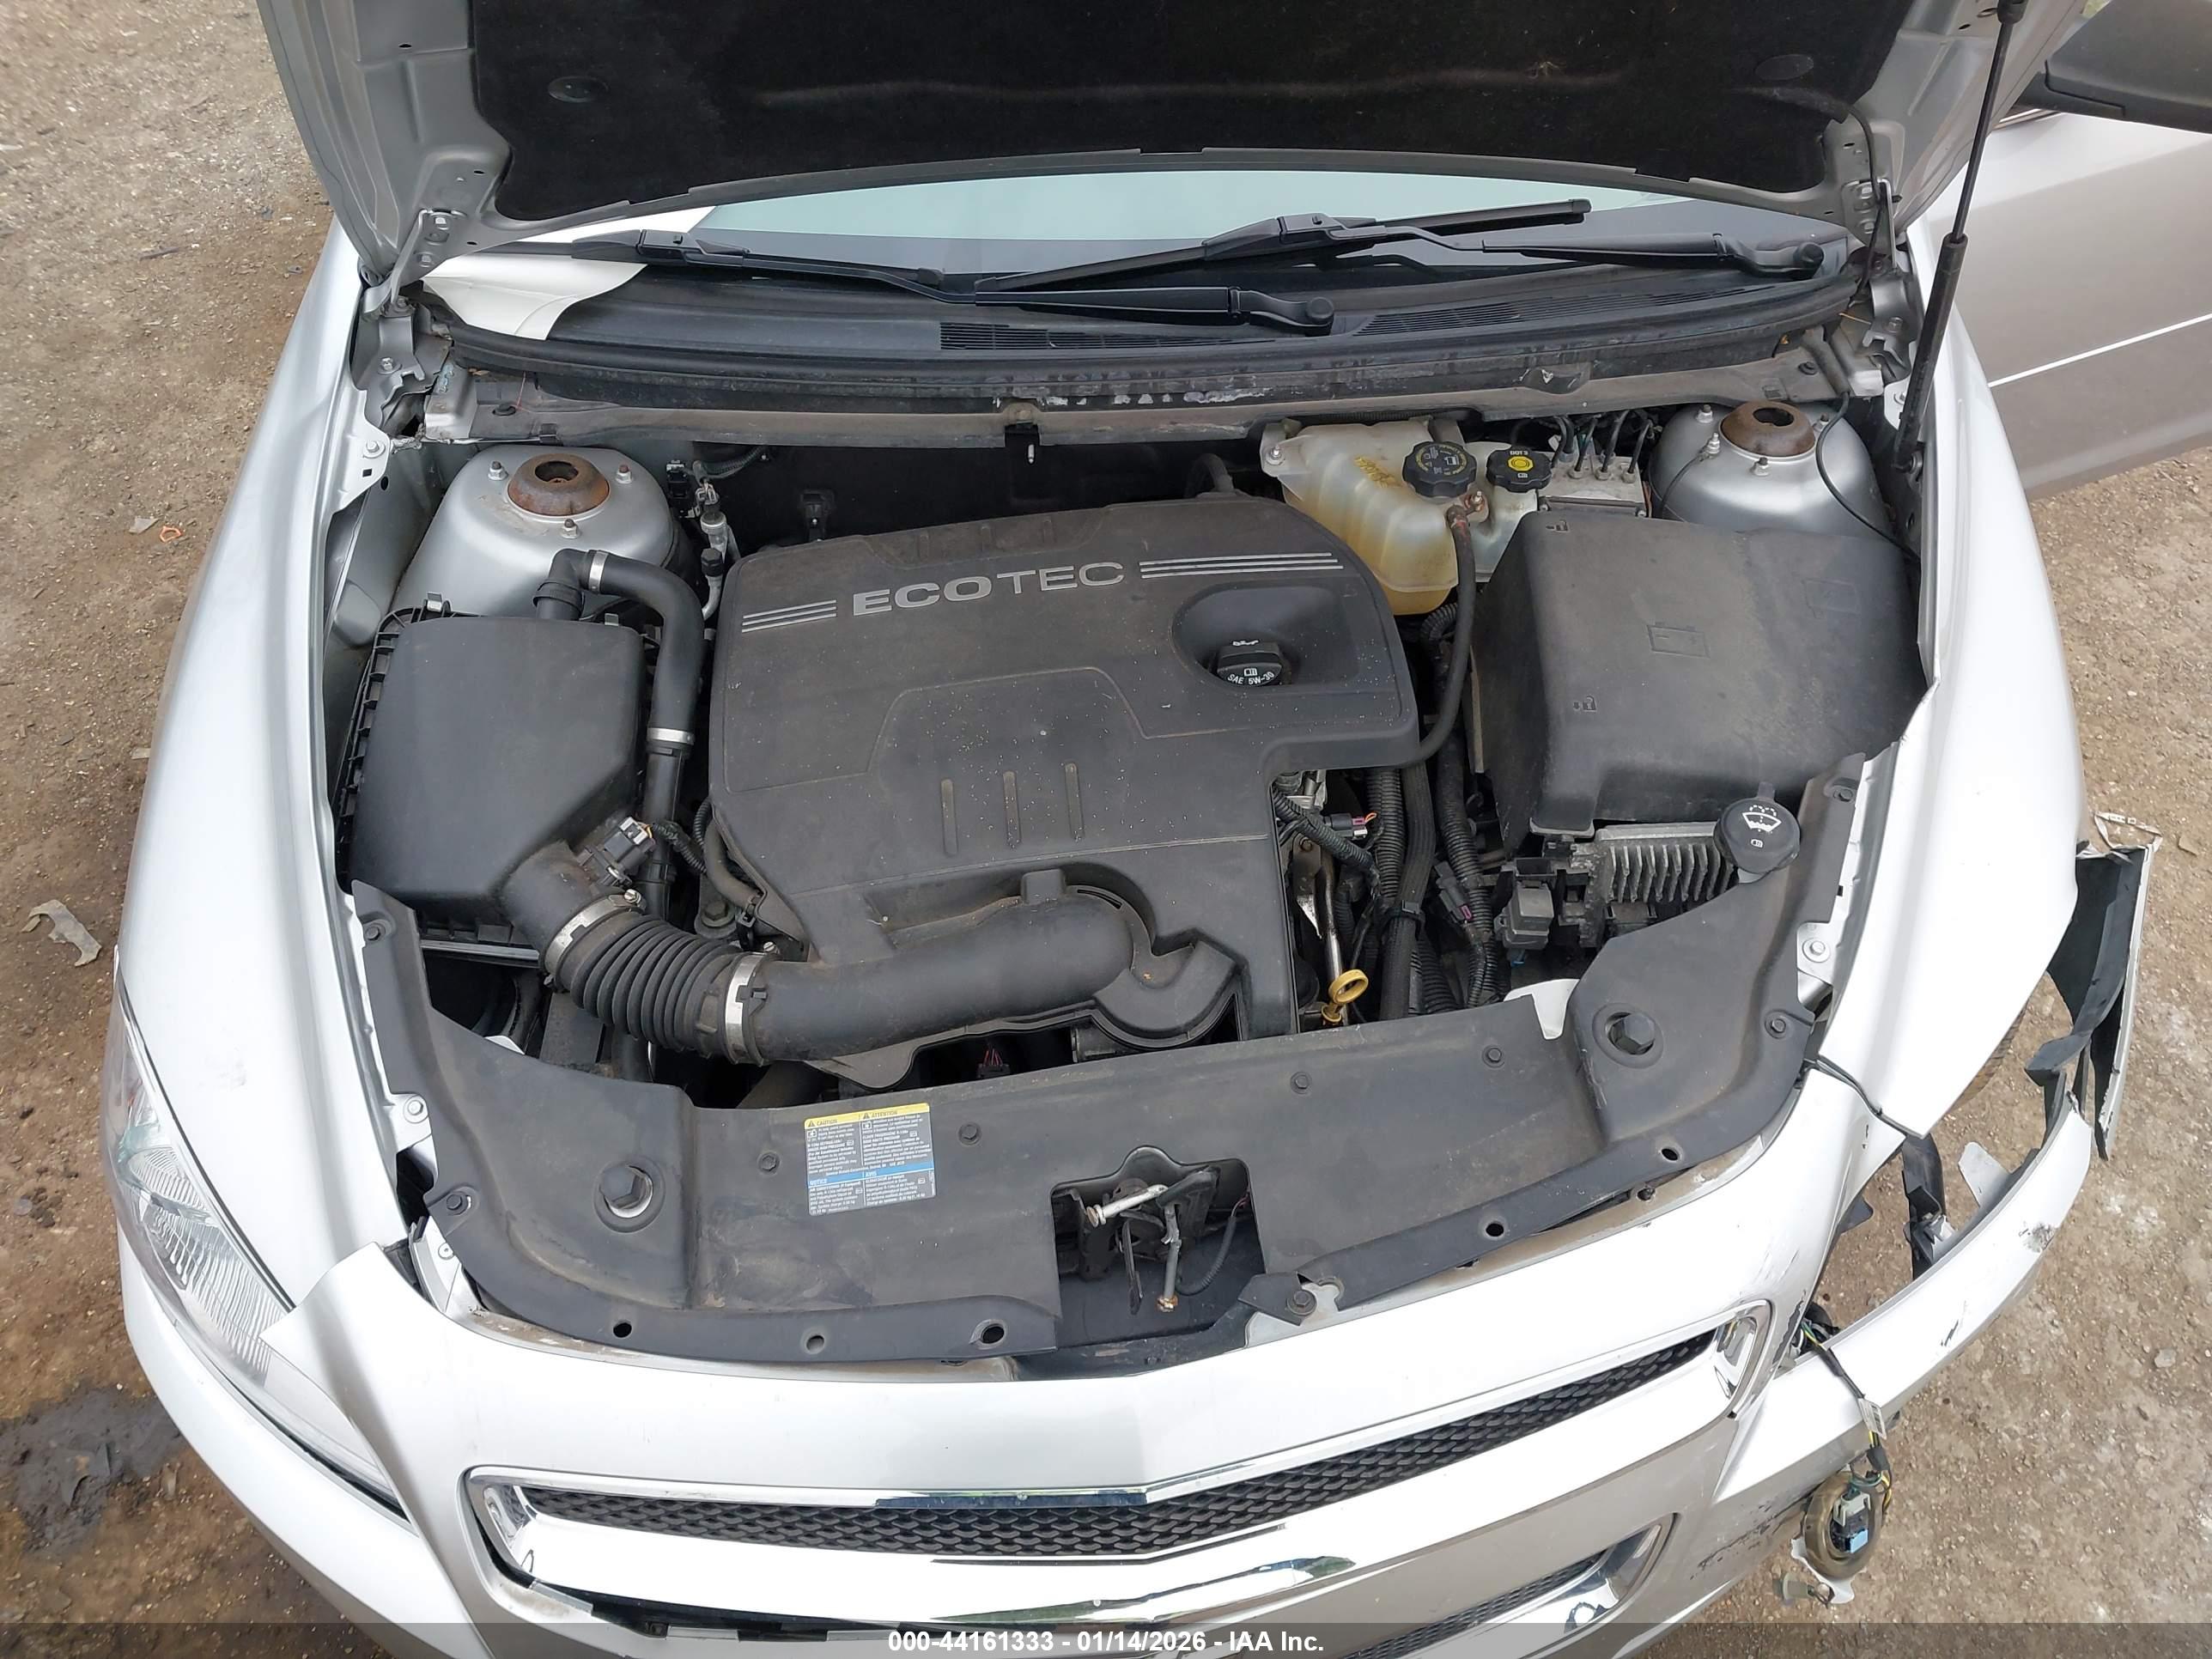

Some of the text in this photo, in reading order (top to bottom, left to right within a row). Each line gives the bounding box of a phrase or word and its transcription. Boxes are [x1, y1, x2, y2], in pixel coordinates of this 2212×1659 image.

[853, 561, 1126, 617] ECOTEC
[1227, 672, 1274, 684] SAE 5W-30
